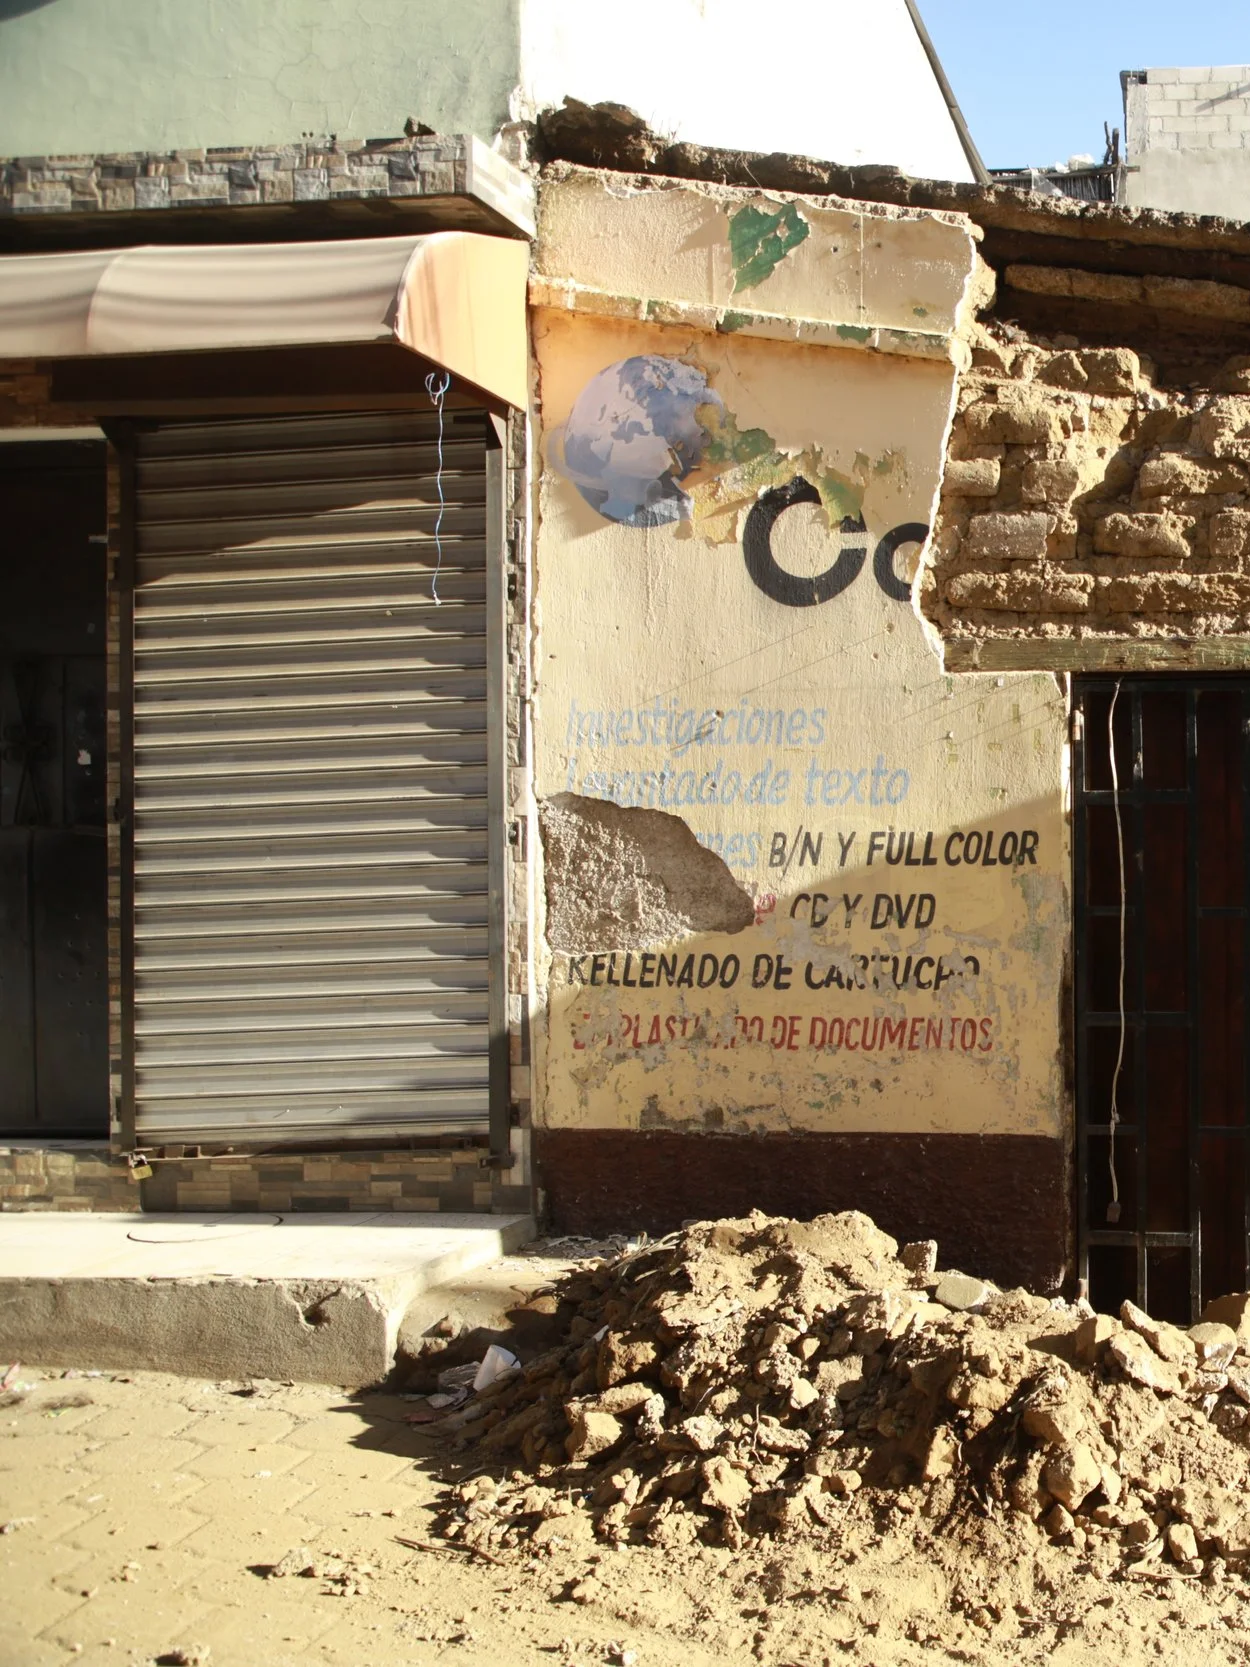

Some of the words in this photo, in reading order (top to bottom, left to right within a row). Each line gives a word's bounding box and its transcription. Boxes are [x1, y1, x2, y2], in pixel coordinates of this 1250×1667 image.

[566, 694, 828, 758] Investigaciones
[744, 758, 791, 805] de
[804, 753, 911, 806] texto
[768, 825, 823, 882] B/N
[838, 831, 857, 867] Y
[866, 830, 938, 867] FULL
[944, 830, 1040, 867] COLOR
[843, 893, 863, 928] Y
[870, 893, 937, 929] DVD
[752, 953, 793, 990] DE
[770, 1015, 803, 1051] DE
[808, 1016, 994, 1052] DOCUMENTOS
